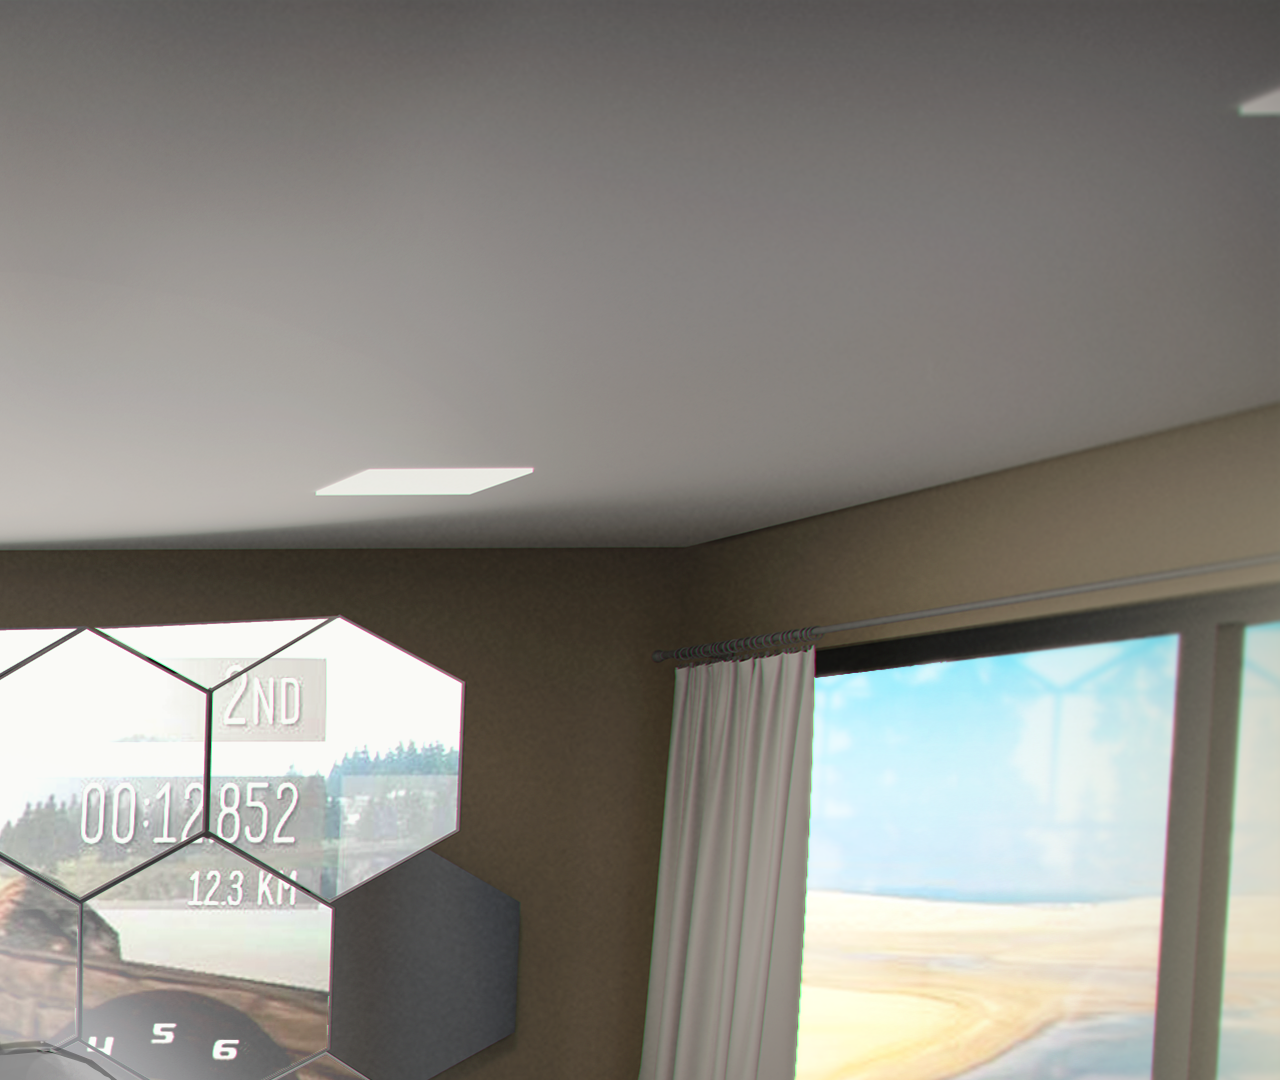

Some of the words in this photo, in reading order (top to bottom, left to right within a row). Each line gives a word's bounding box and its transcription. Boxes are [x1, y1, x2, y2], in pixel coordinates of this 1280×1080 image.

[223, 664, 301, 725] 2ND
[188, 870, 244, 906] 12.3
[256, 870, 298, 906] KM
[151, 1023, 177, 1044] 5
[86, 1036, 114, 1056] 4
[212, 1039, 239, 1060] 6
